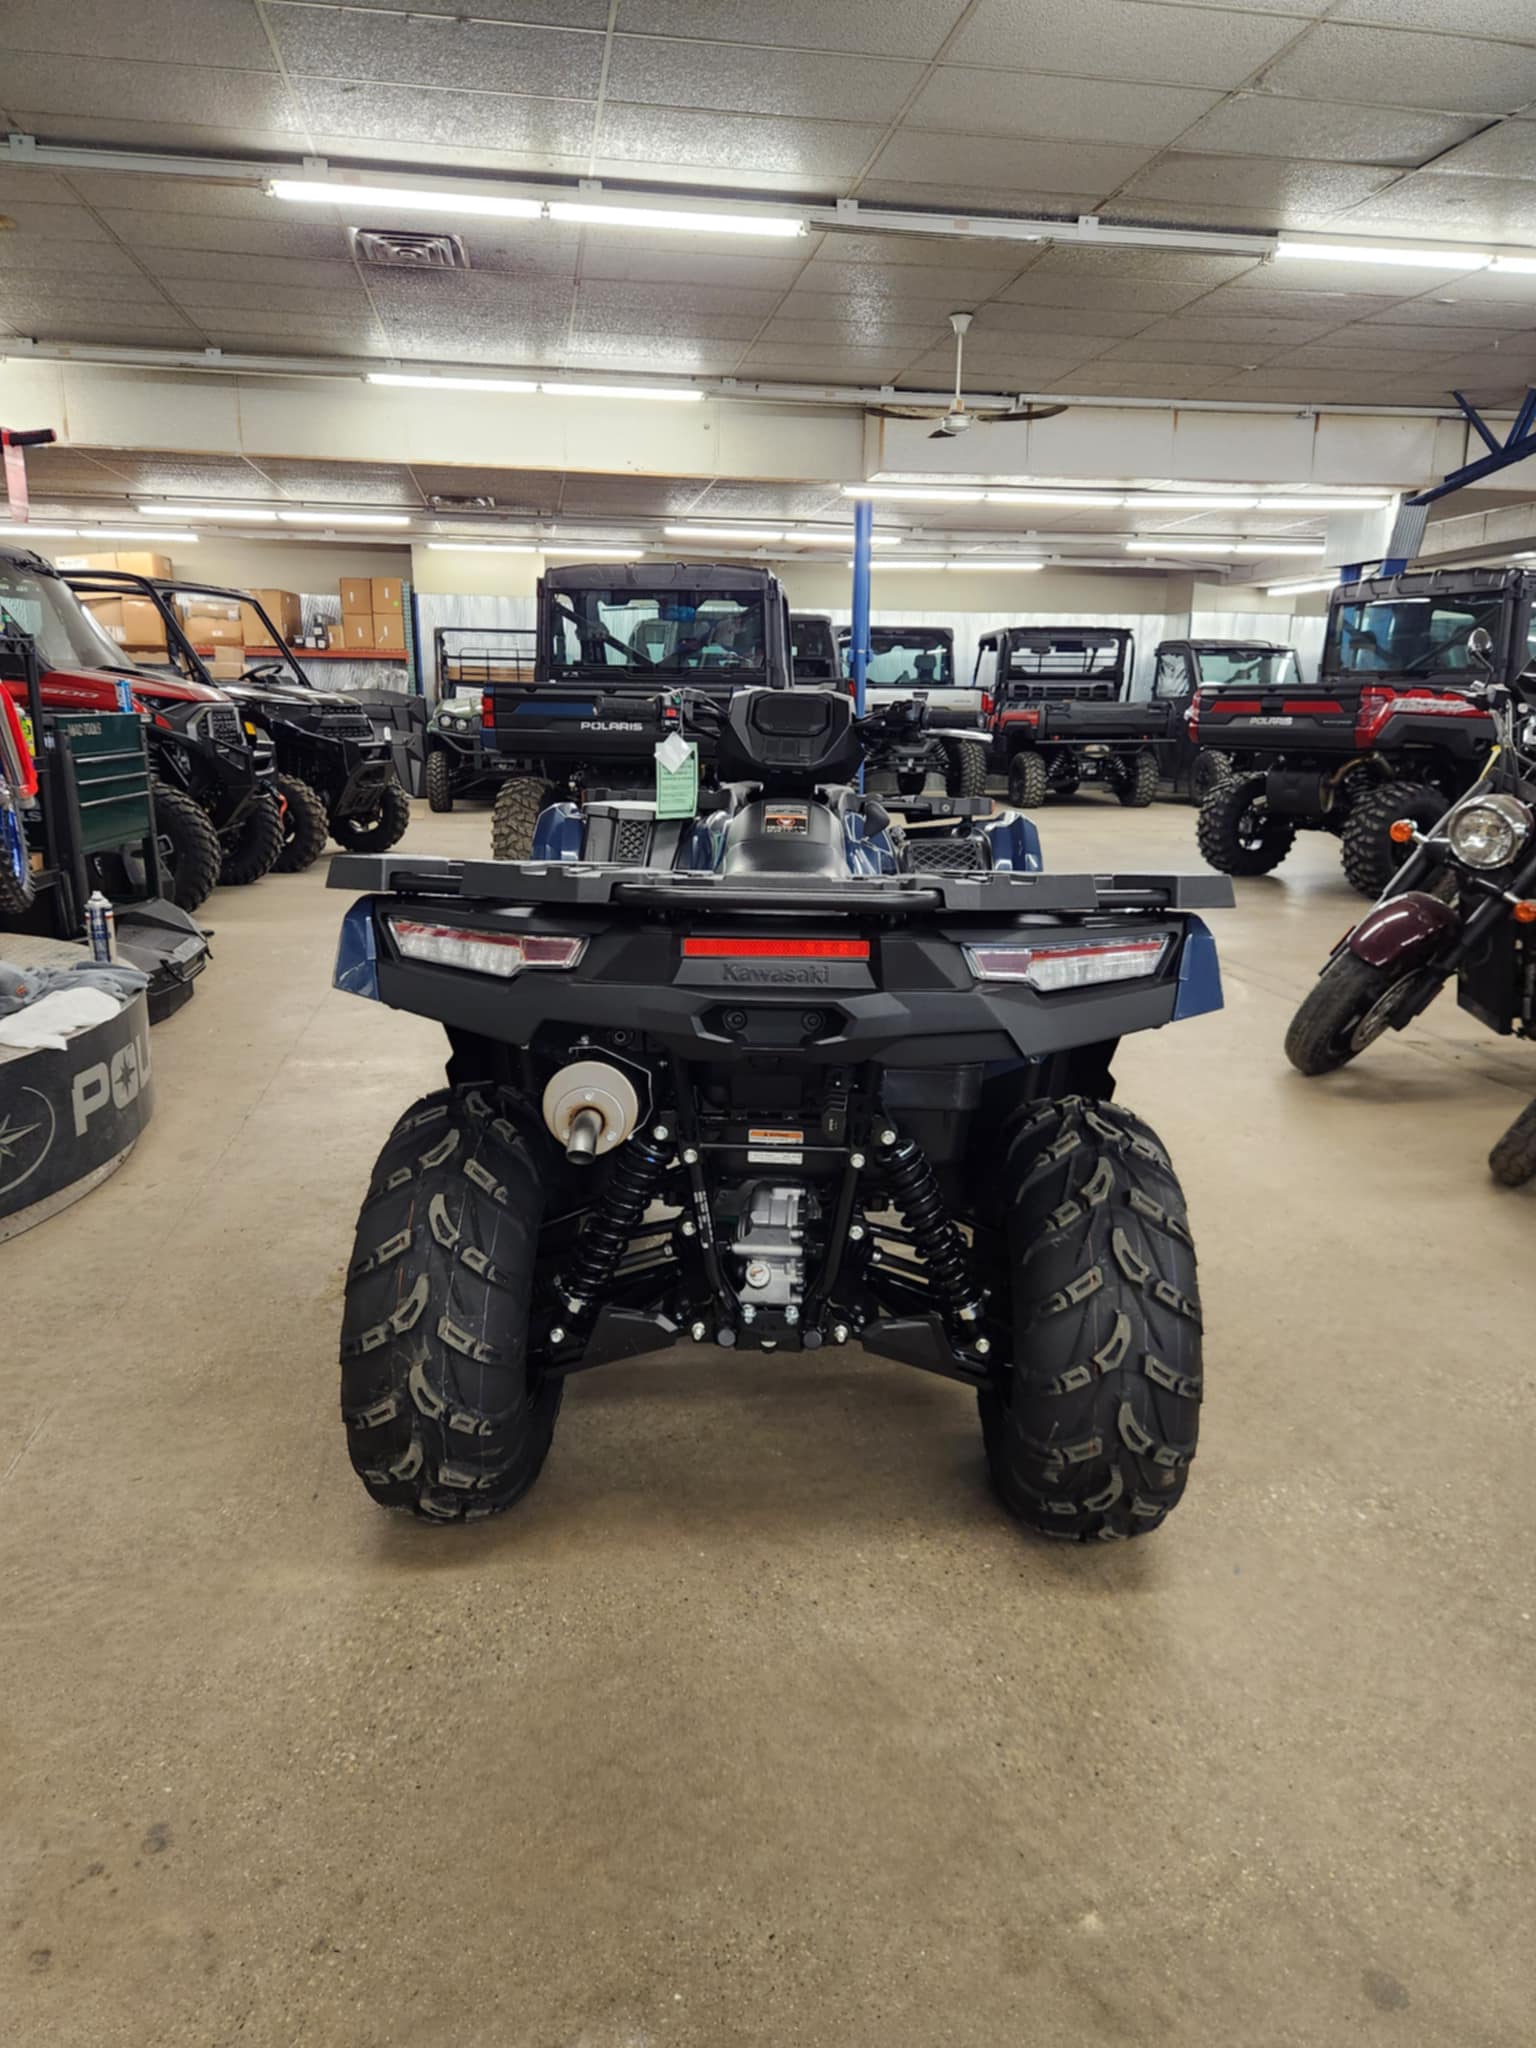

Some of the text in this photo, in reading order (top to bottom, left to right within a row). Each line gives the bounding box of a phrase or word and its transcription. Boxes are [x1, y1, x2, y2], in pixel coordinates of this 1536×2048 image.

[580, 721, 644, 732] POLARIS
[1249, 716, 1294, 726] POLARIS
[722, 963, 830, 985] Kawasaki
